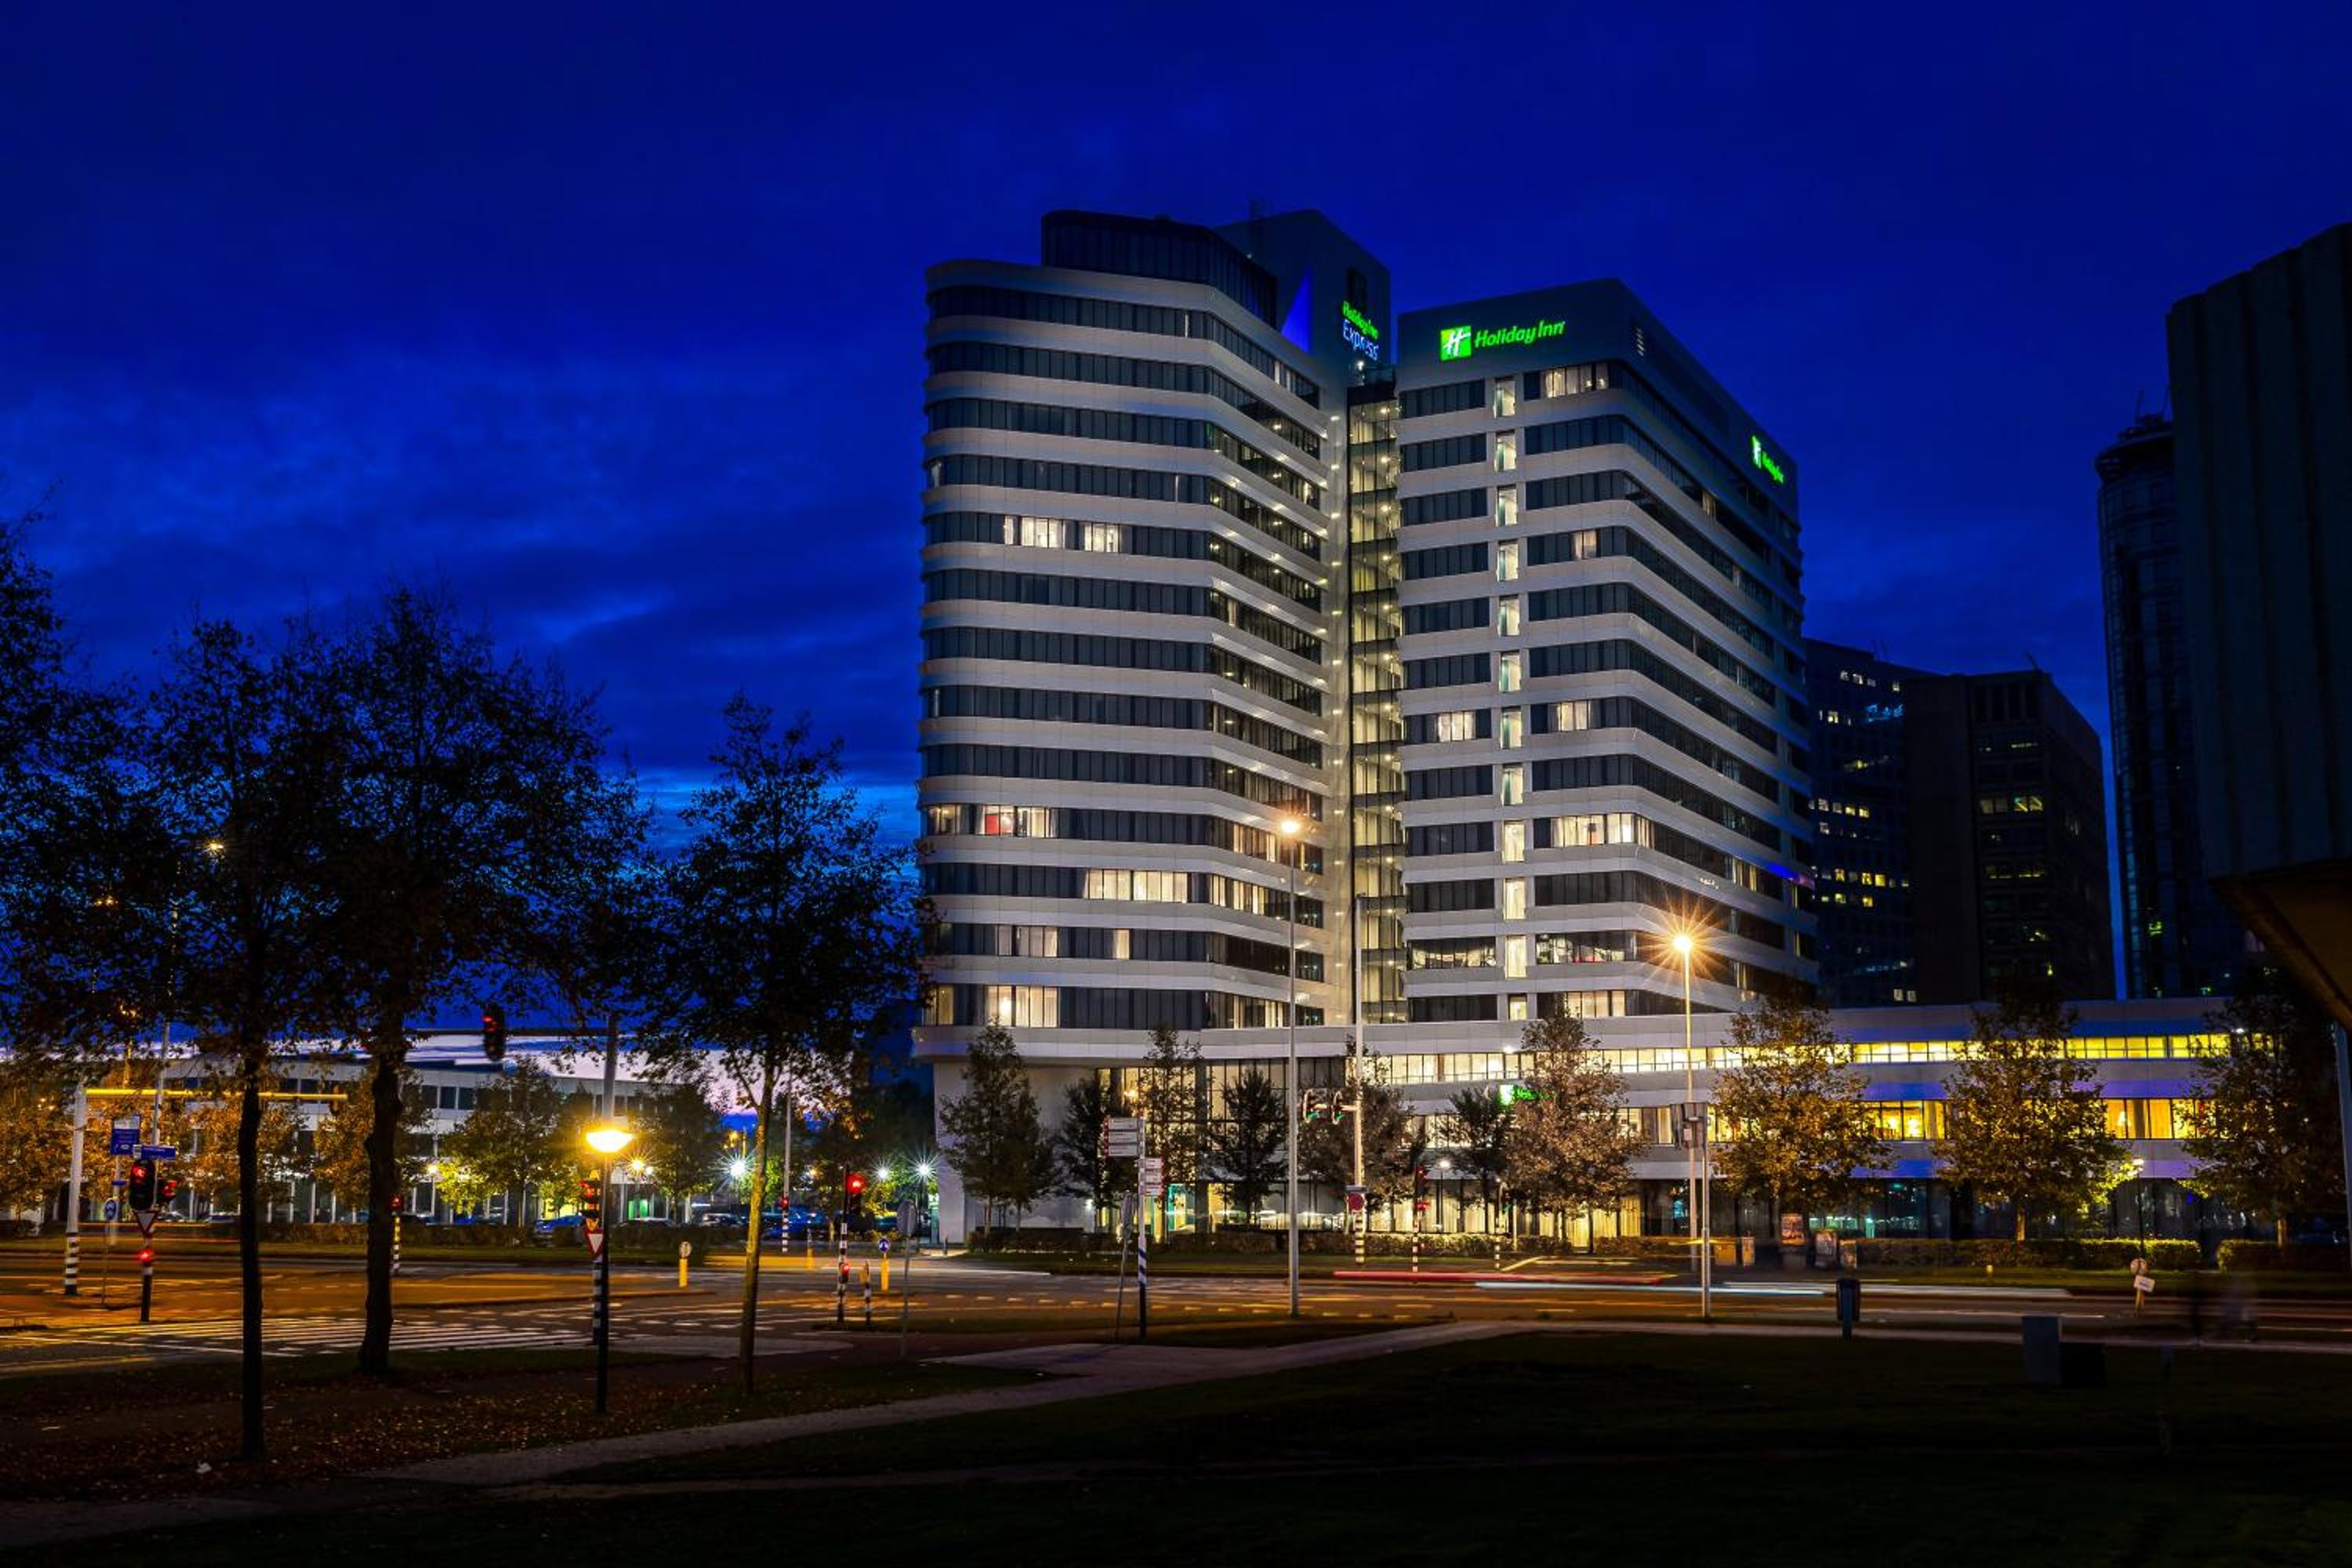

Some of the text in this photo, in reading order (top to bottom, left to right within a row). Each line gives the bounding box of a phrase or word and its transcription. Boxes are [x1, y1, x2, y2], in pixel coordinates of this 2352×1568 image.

[1343, 318, 1379, 361] Express
[1474, 325, 1537, 348] Holiday
[1537, 319, 1565, 338] Inn
